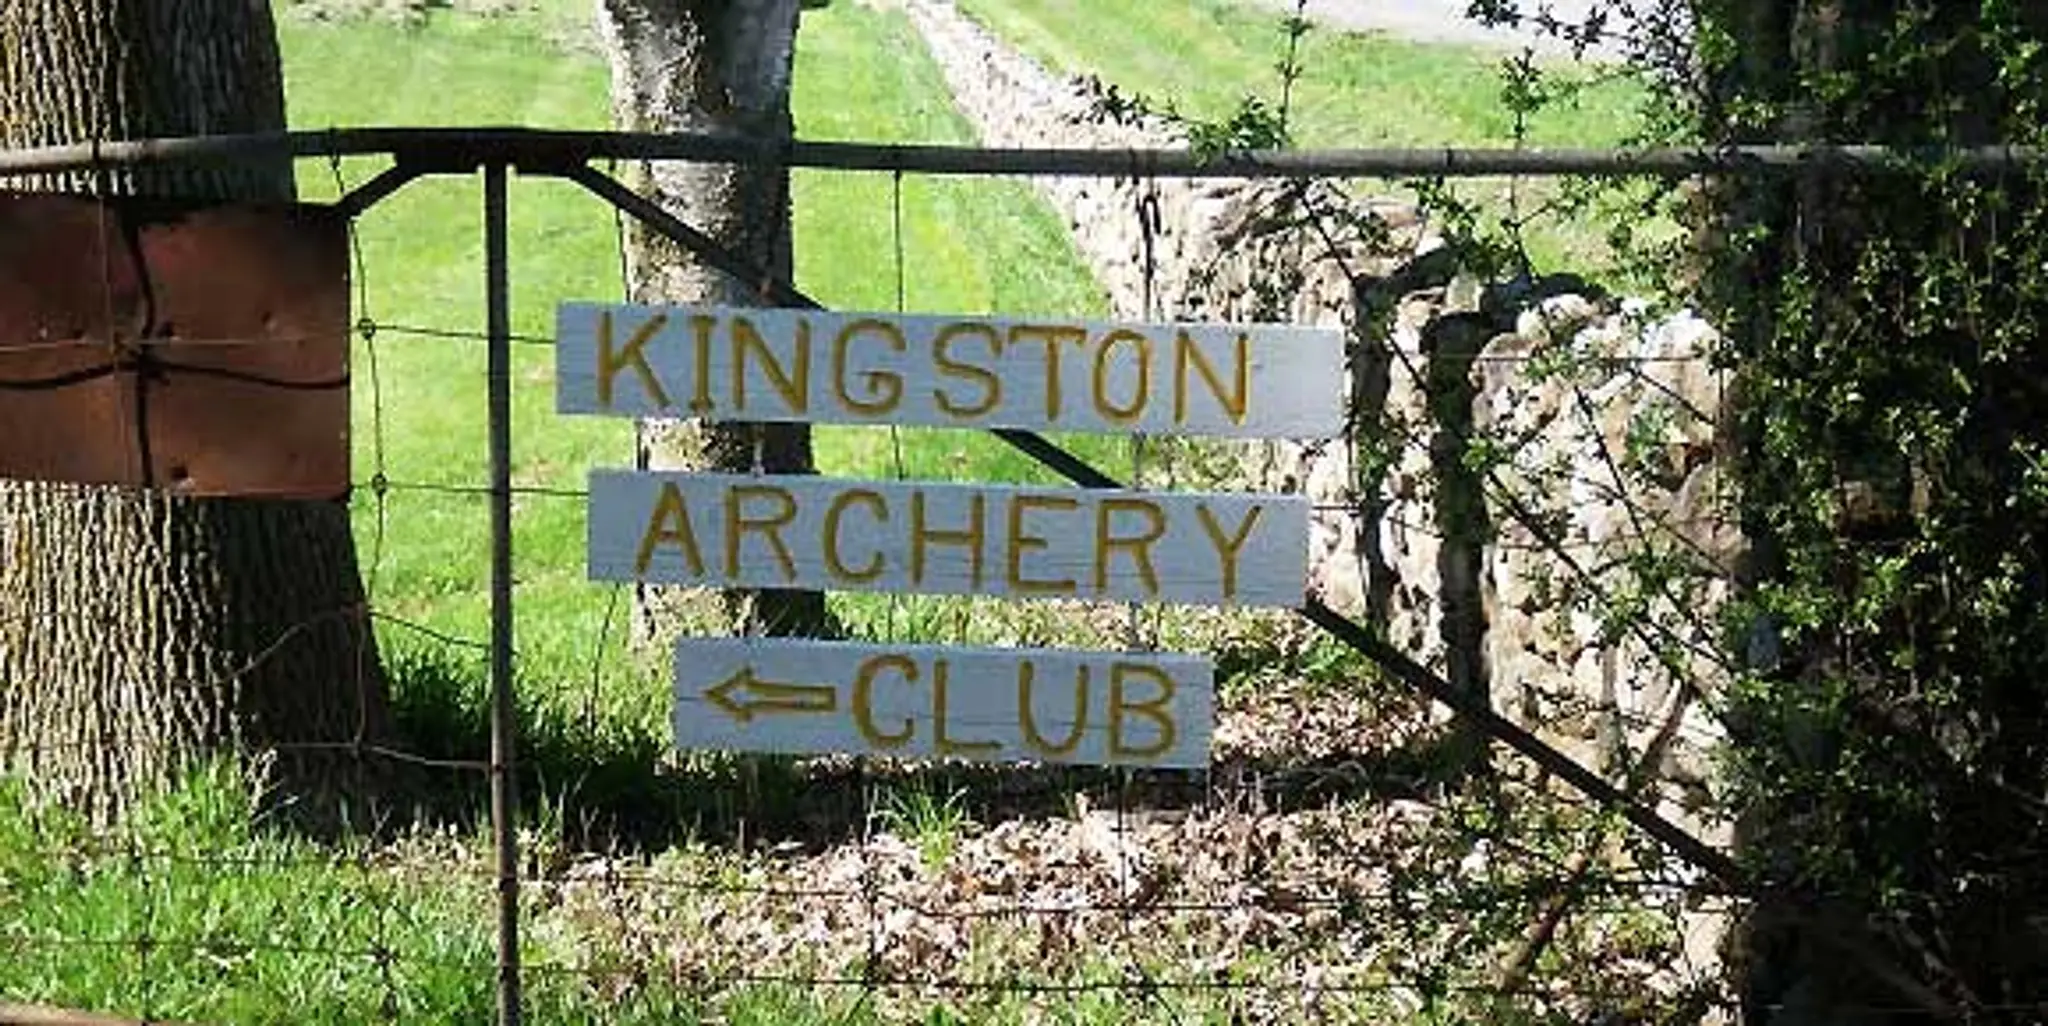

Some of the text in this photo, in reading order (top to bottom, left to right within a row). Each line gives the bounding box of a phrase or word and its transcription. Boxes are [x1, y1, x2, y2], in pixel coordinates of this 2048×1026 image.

[596, 312, 1251, 426] KINGSTON
[633, 481, 1264, 597] ARCHERY
[849, 653, 1179, 760] CLUB
